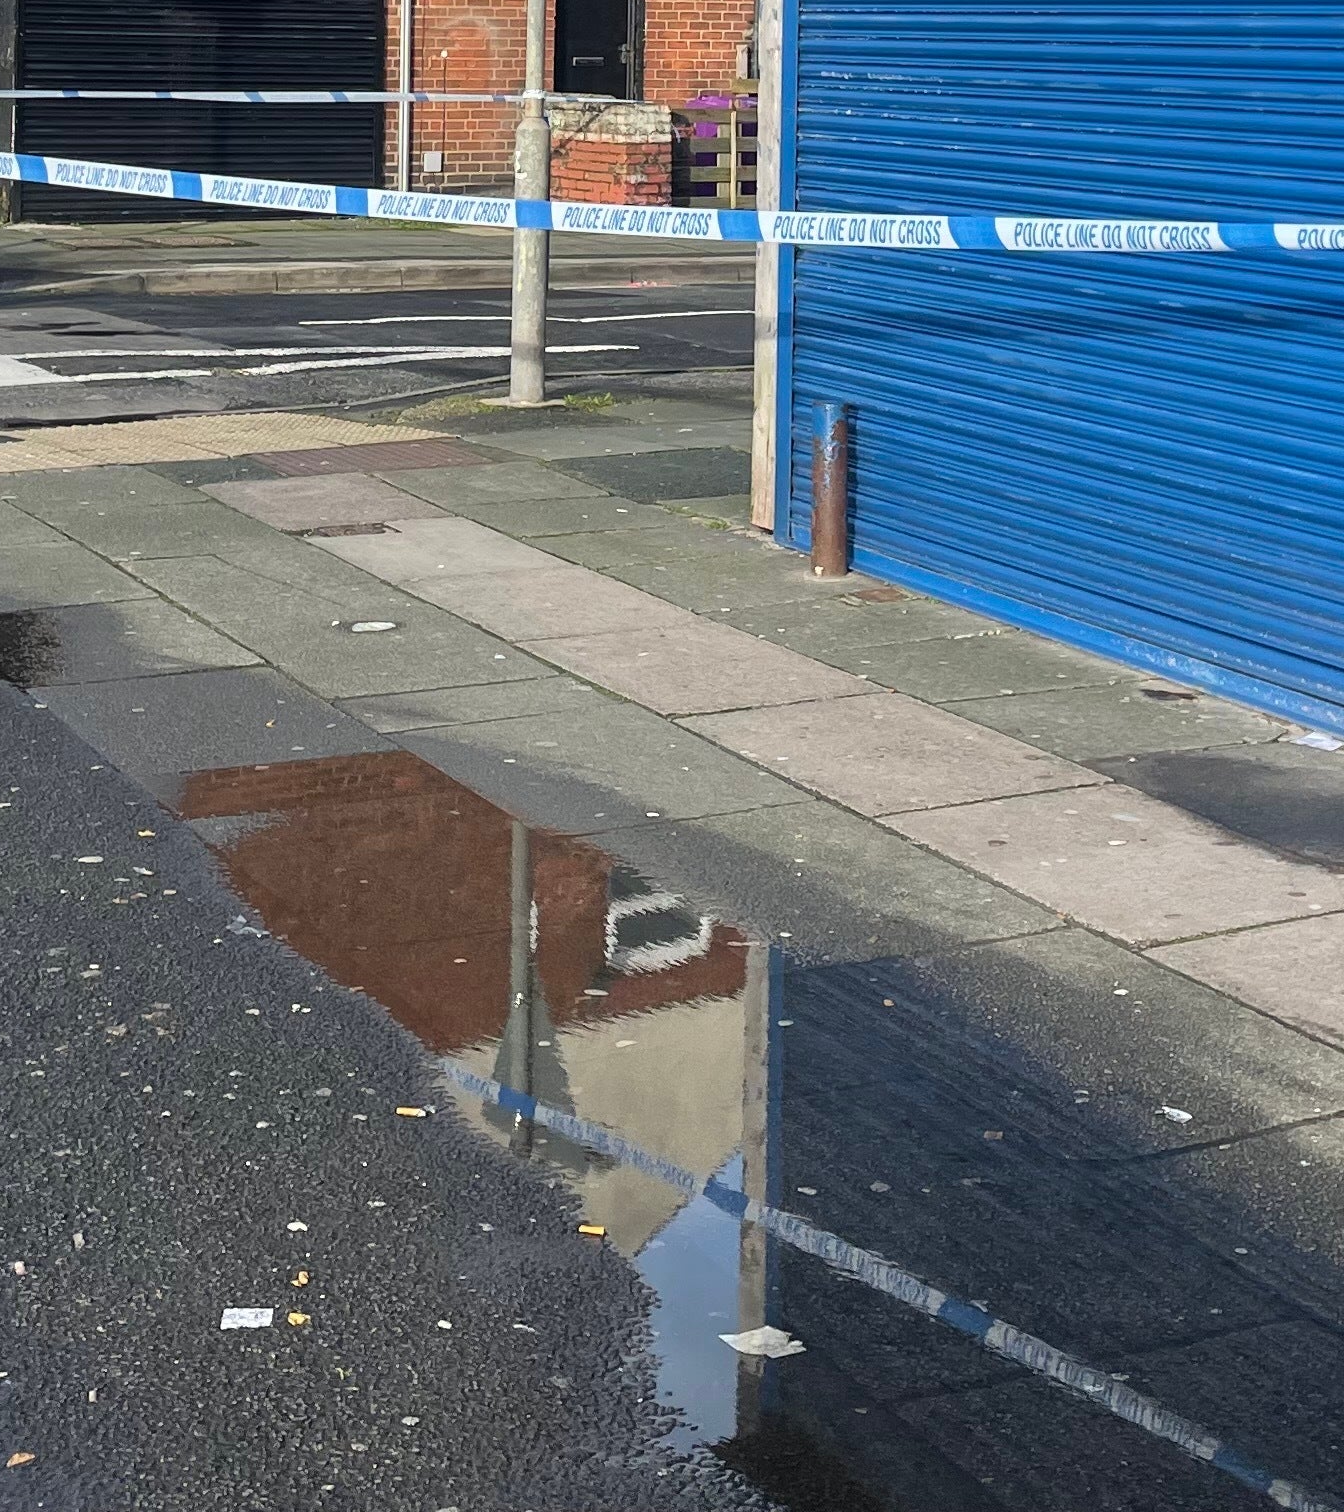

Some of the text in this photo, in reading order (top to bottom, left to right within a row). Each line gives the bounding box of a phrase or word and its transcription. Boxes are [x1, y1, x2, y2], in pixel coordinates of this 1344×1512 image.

[55, 163, 167, 193] POLICE LINE DO NOT CROSS
[210, 179, 331, 209] POLICE LINE DO NOT CROSS
[376, 194, 510, 223] POLICE LINE DO NOT CROSS
[562, 206, 711, 235] POLICE LINE DO NOT CROSS
[773, 215, 942, 245] POLICE LINE DO NOT CROSS
[1014, 222, 1213, 250] POLICE LINE DO NOT CROSS
